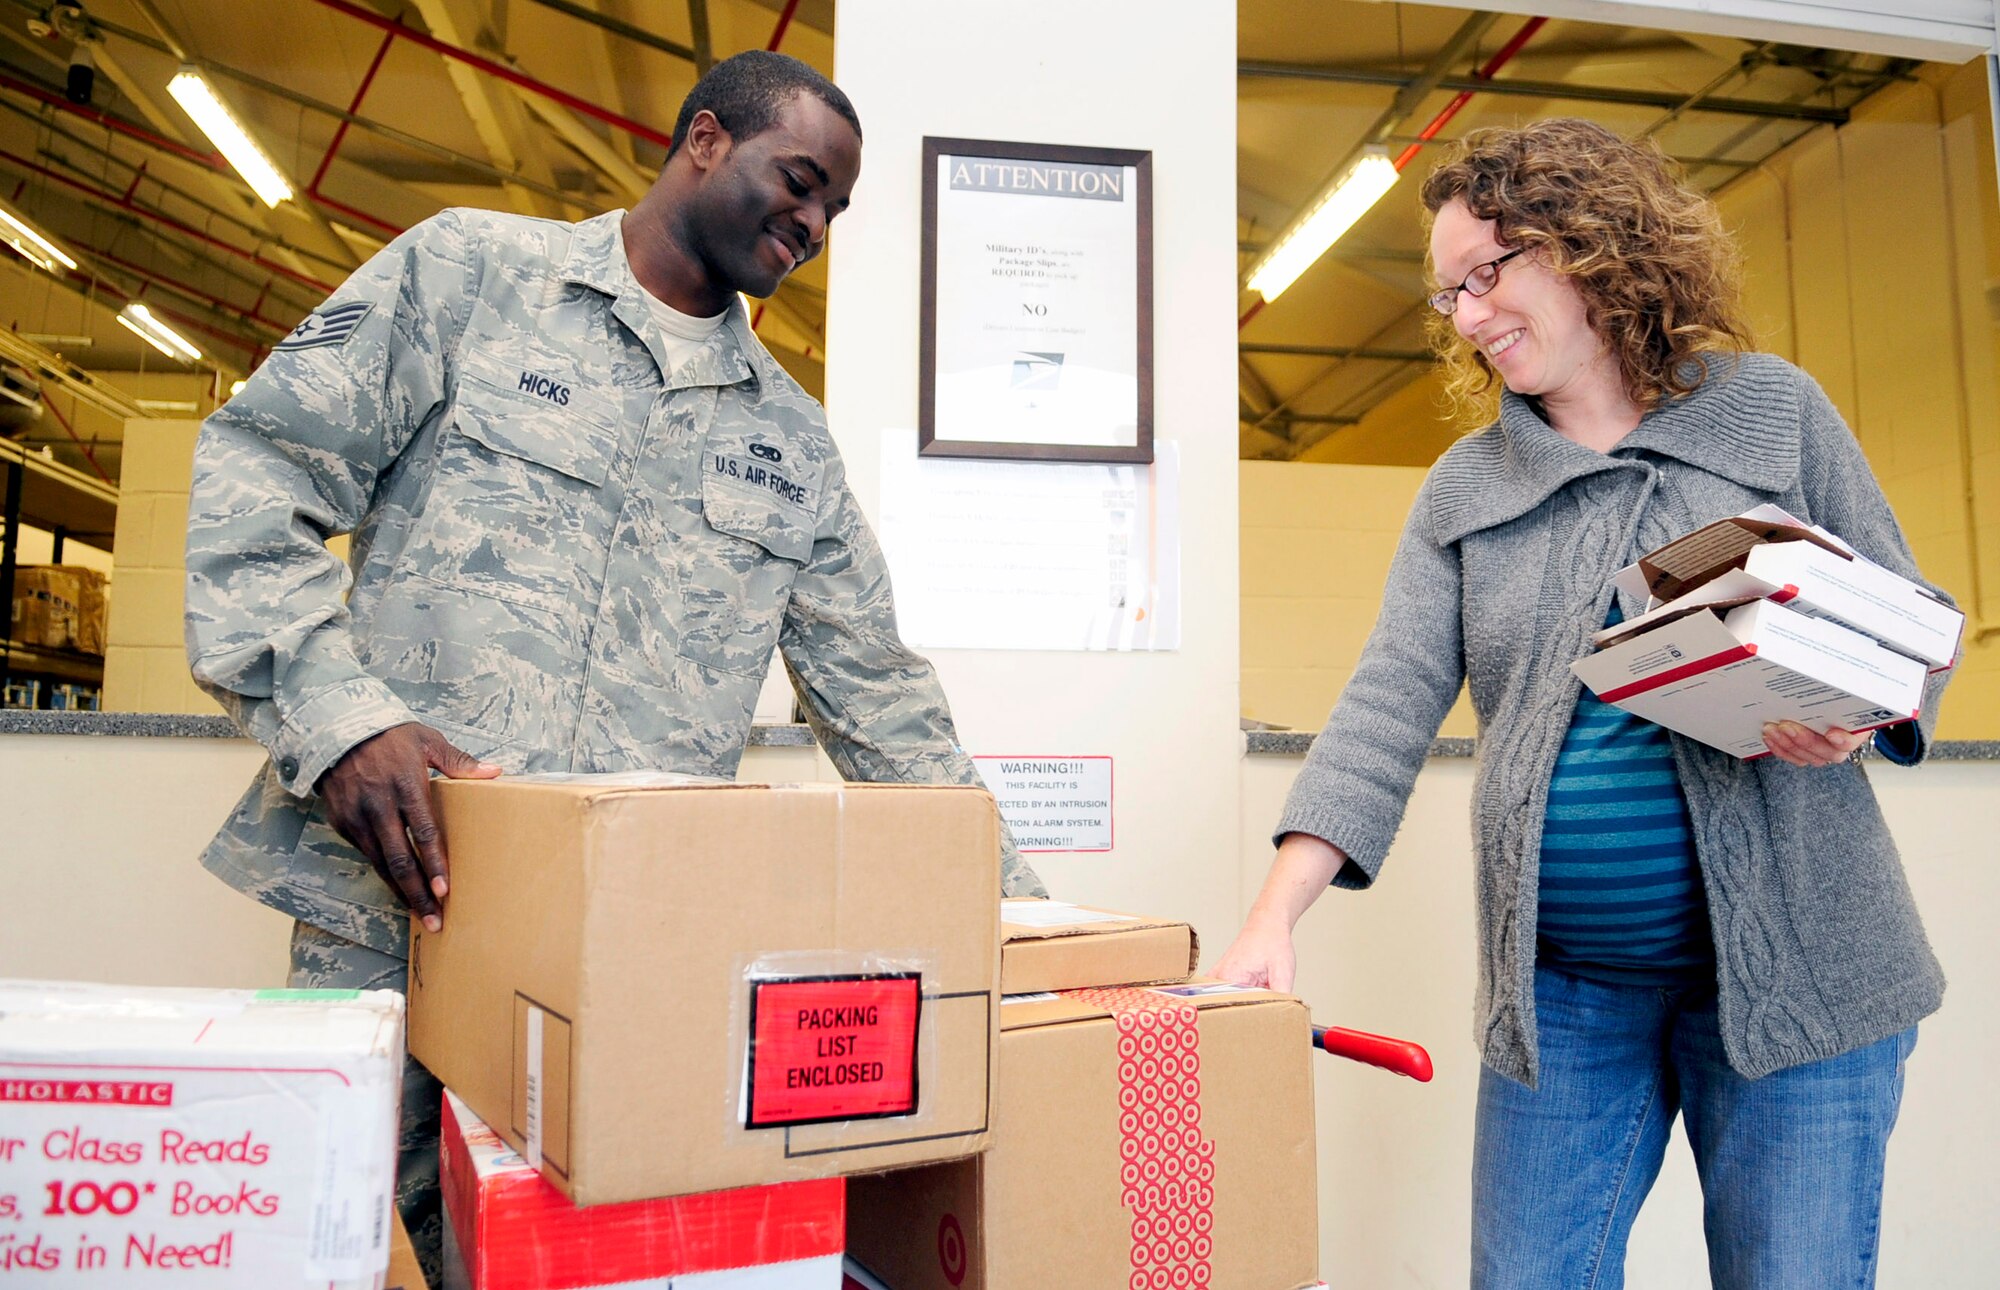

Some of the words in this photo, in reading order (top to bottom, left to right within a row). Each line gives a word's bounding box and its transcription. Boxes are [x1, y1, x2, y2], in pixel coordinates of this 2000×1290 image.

[952, 163, 1120, 196] ATTENTION
[986, 244, 1022, 255] Military
[992, 268, 1045, 279] REQUIRED
[999, 257, 1034, 267] Package
[1023, 303, 1048, 317] NO
[518, 371, 570, 405] HICKS
[715, 455, 740, 478] U.S.
[745, 465, 766, 487] AIR
[769, 472, 806, 504] FORCE
[1000, 762, 1084, 774] WARNING!!!
[1006, 781, 1025, 790] THIS
[1028, 781, 1067, 790] FACILITY
[1069, 781, 1078, 790] IS
[1031, 800, 1043, 808] BY
[1044, 800, 1056, 808] AN
[1059, 800, 1107, 808] INTRUSION
[1033, 819, 1063, 827] ALARM
[797, 1005, 878, 1030] PACKING
[817, 1035, 857, 1058] LIST
[787, 1061, 884, 1089] ENCLOSED
[43, 1126, 143, 1164] Class
[160, 1129, 270, 1166] Reads
[171, 1180, 280, 1217] Books
[76, 1236, 106, 1270] in
[124, 1230, 233, 1270] Need!
